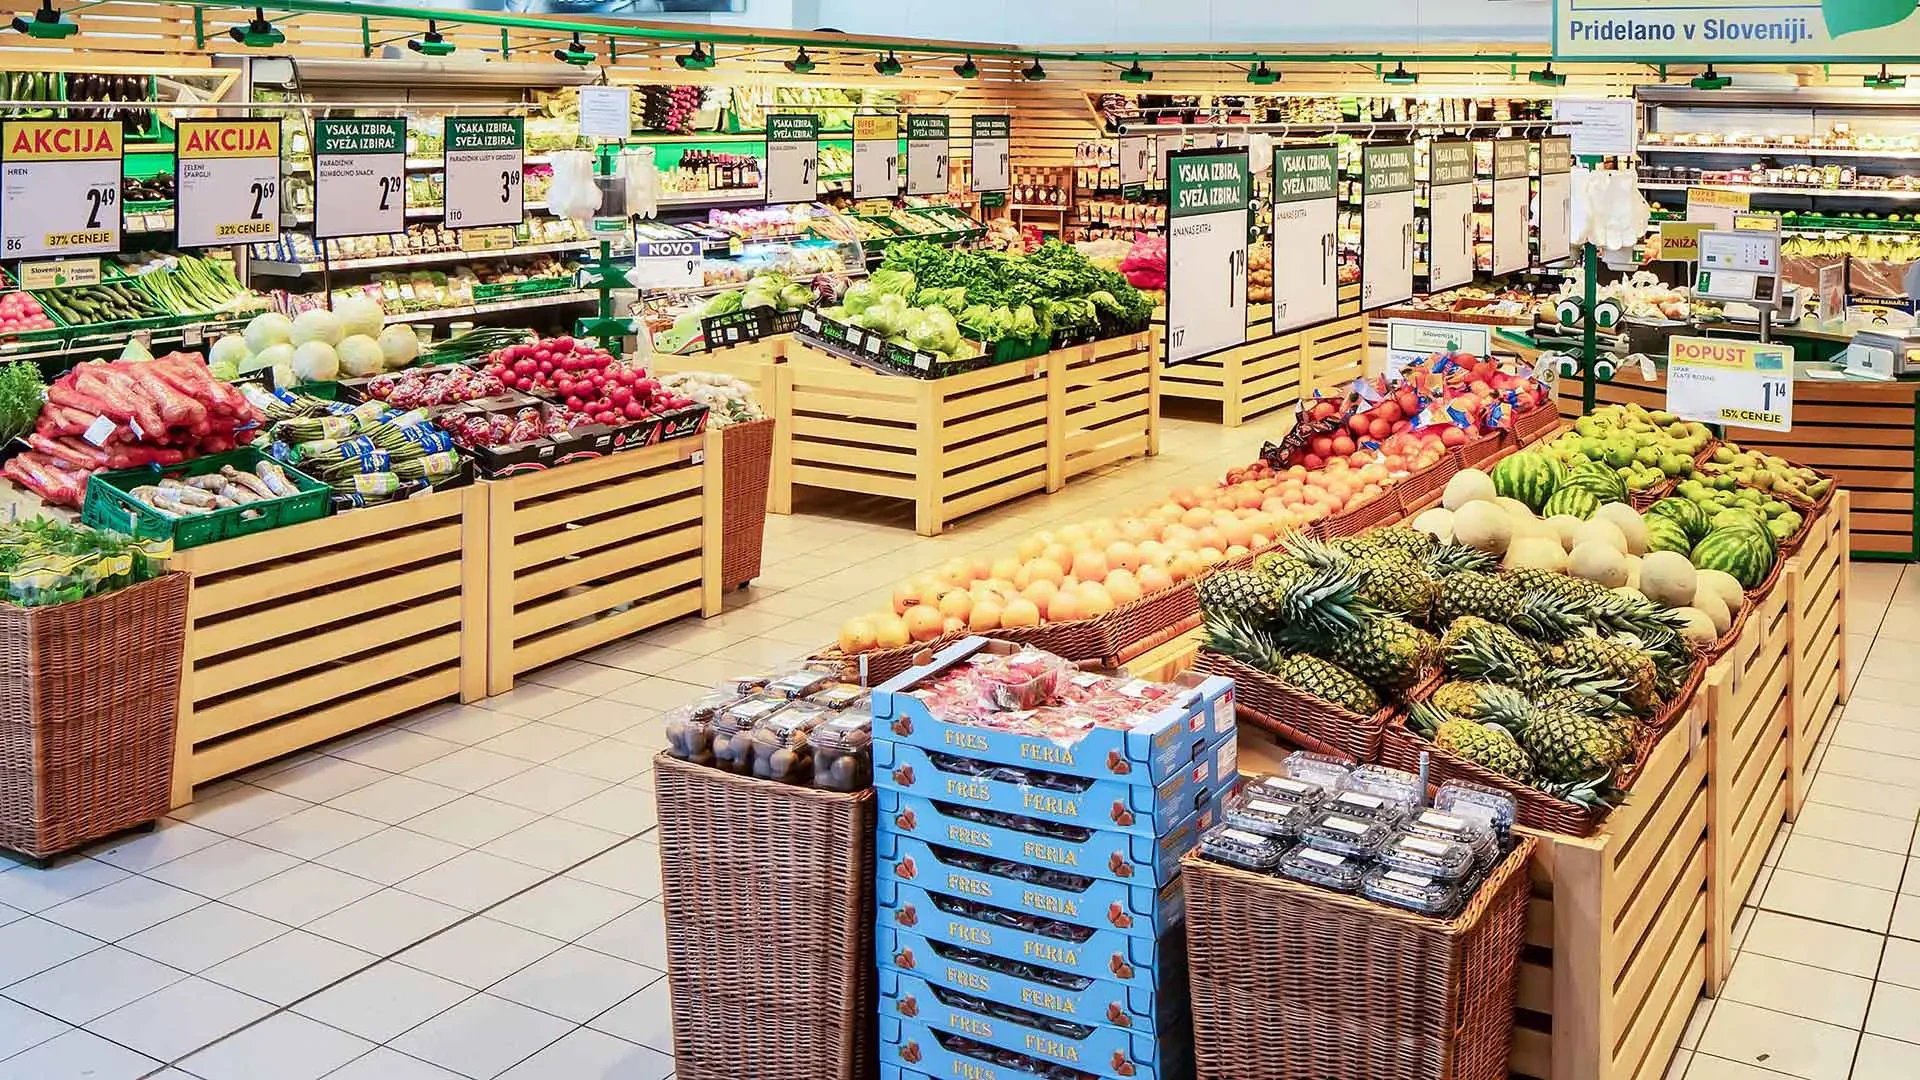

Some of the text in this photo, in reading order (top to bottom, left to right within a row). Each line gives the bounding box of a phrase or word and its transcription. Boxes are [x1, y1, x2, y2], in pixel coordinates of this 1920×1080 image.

[1570, 18, 1813, 44] Pridelano v Sloveniji.
[325, 123, 396, 137] VSAKA IZBIRA,
[455, 122, 516, 134] VSAKA IZBIRA,
[12, 127, 114, 153] AKCIJA
[185, 128, 273, 152] AKCIJA
[326, 136, 395, 151] SVEŽA IZBIRA!
[456, 134, 515, 147] SVEŽA IZBIRA!
[1281, 154, 1332, 171] VSAKA IZBIRA,
[1178, 162, 1241, 184] VSAKA IZBIRA,
[1282, 174, 1331, 195] SVEŽA IZBIRA!
[1180, 184, 1240, 208] SVEŽA IZBIRA!
[449, 210, 462, 221] 110
[220, 223, 271, 235] 32% CENEJE
[6, 239, 22, 250] 86
[49, 233, 110, 246] 37% CENEJE
[648, 243, 694, 256] NOVO
[1171, 329, 1185, 348] 117
[1674, 343, 1746, 363] POPUST
[1721, 409, 1781, 424] 15% CENEJE
[944, 728, 1076, 766] FRES FERIA
[946, 778, 1078, 817] FRES FERIA
[948, 824, 1078, 866] FRES FERIA
[948, 873, 1078, 918] FRES FERIA
[949, 921, 1078, 967] FRES FERIA
[946, 966, 1076, 1014] FRES FERIA
[950, 1014, 1079, 1062] FRES FERIA
